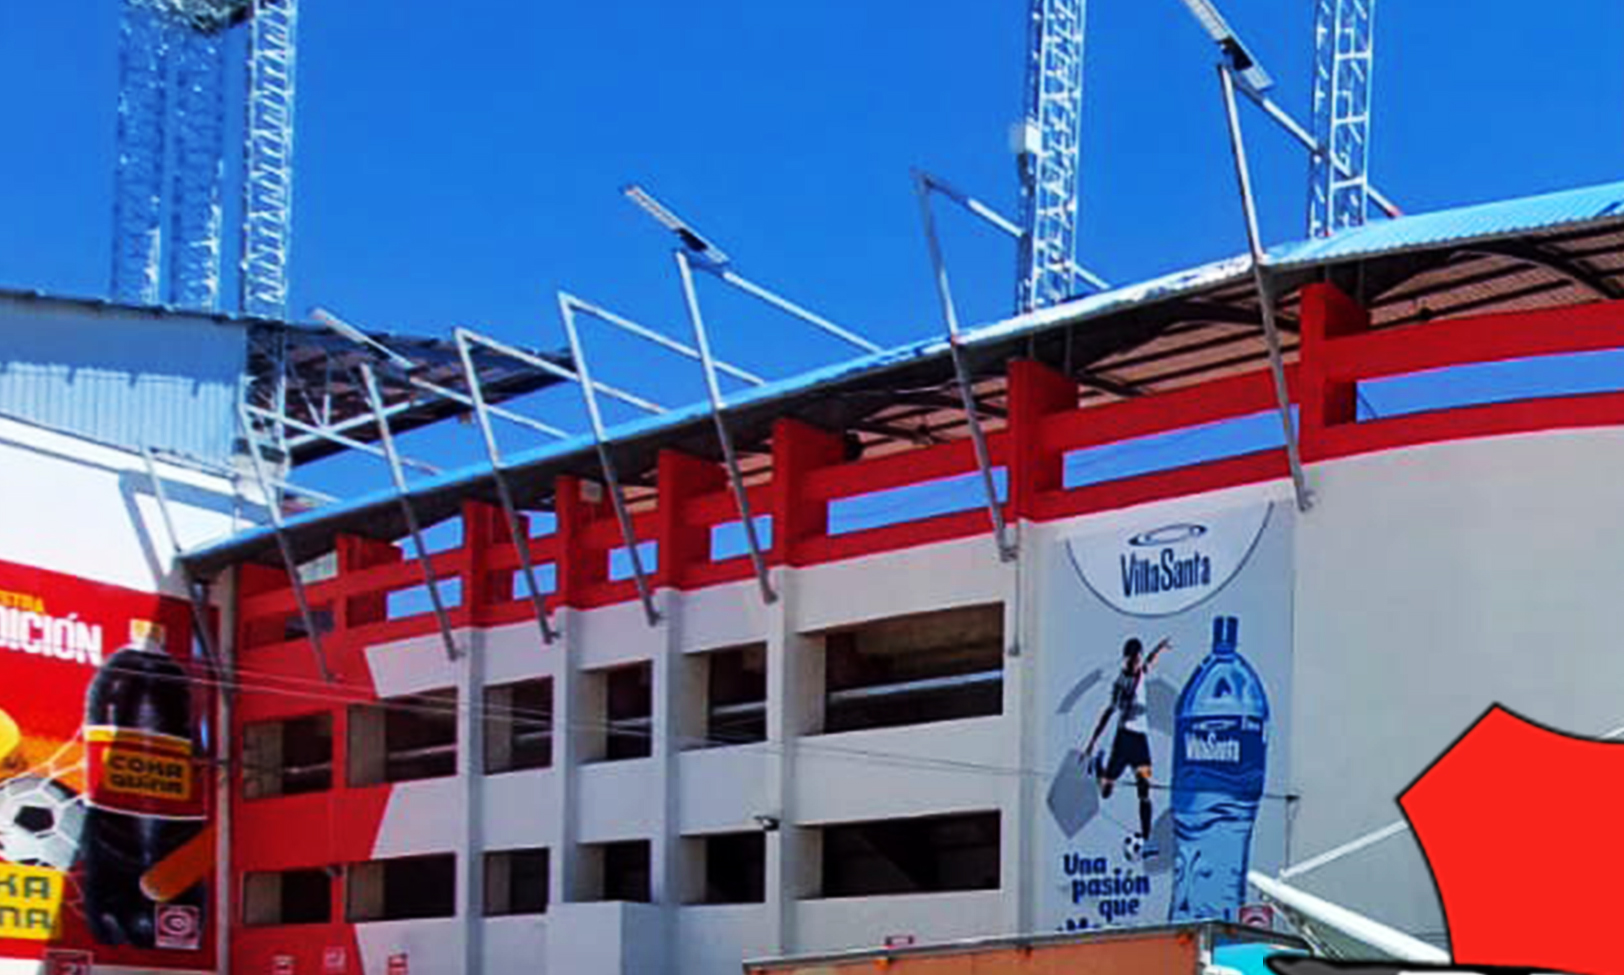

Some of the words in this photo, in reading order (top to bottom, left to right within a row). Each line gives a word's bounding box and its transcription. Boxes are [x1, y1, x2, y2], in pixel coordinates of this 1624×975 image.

[1120, 547, 1211, 598] VillaSanta
[1063, 852, 1108, 876] Una
[1072, 867, 1150, 903] pasión
[1099, 898, 1140, 923] que
